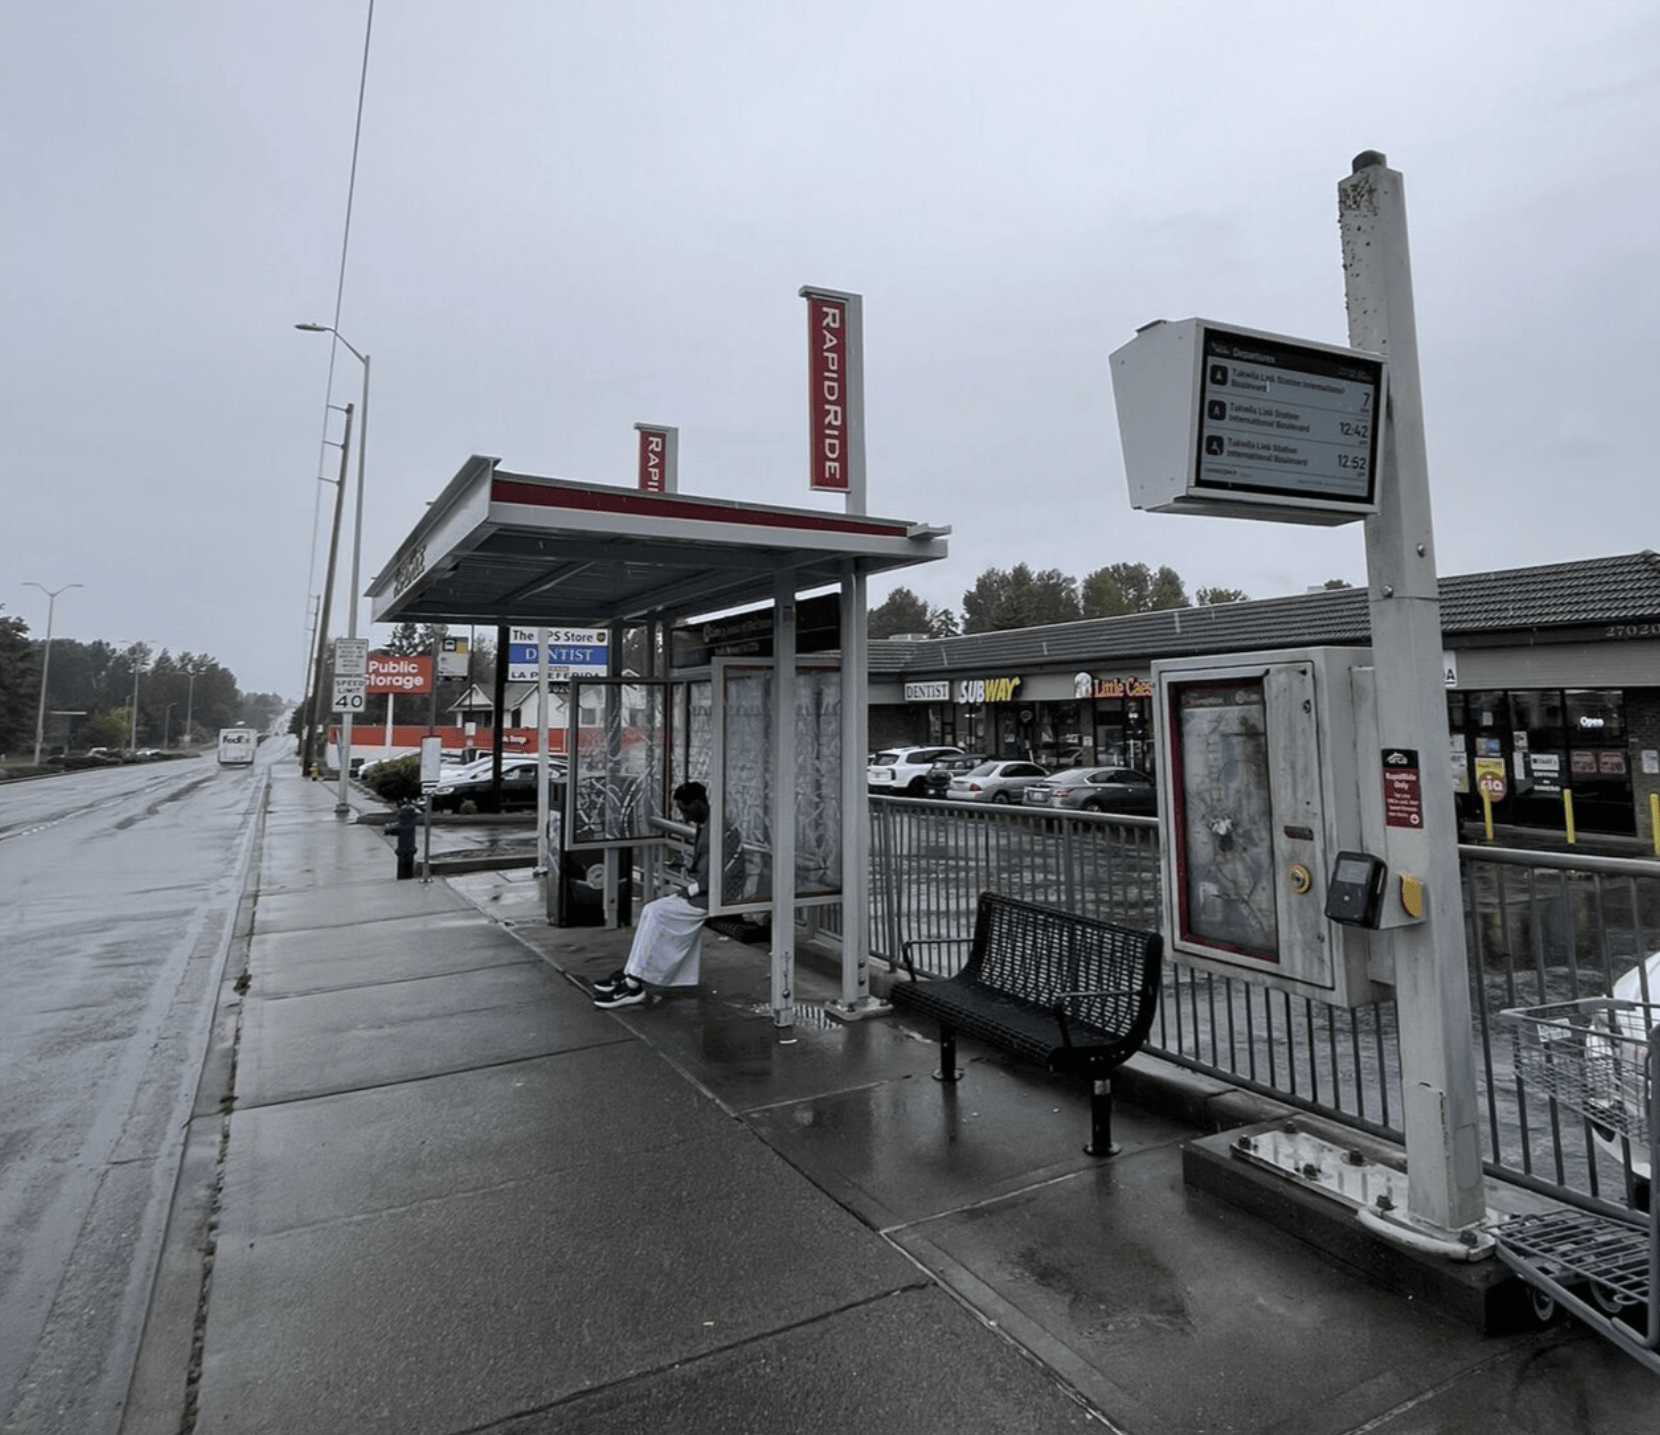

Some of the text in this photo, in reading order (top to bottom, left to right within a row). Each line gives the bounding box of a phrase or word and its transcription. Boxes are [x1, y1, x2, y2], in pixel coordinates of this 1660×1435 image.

[822, 305, 841, 480] RAPIDRIDE
[1363, 392, 1371, 408] 7
[1339, 421, 1369, 440] 12:42
[647, 436, 663, 492] RAPI
[1337, 453, 1367, 471] 12:52
[512, 630, 534, 642] The
[564, 631, 594, 643] Store
[1605, 624, 1660, 637] 27020
[525, 647, 594, 662] DNTIST
[368, 660, 419, 674] Public
[511, 671, 602, 679] LA PEFERIDA
[1446, 668, 1455, 681] A
[335, 679, 365, 687] SPEED
[958, 676, 1021, 704] SUBWAY
[1093, 678, 1124, 698] Little
[906, 682, 949, 700] DENTIST
[334, 695, 363, 709] 40
[1580, 716, 1605, 729] Open
[222, 734, 250, 745] FedEx
